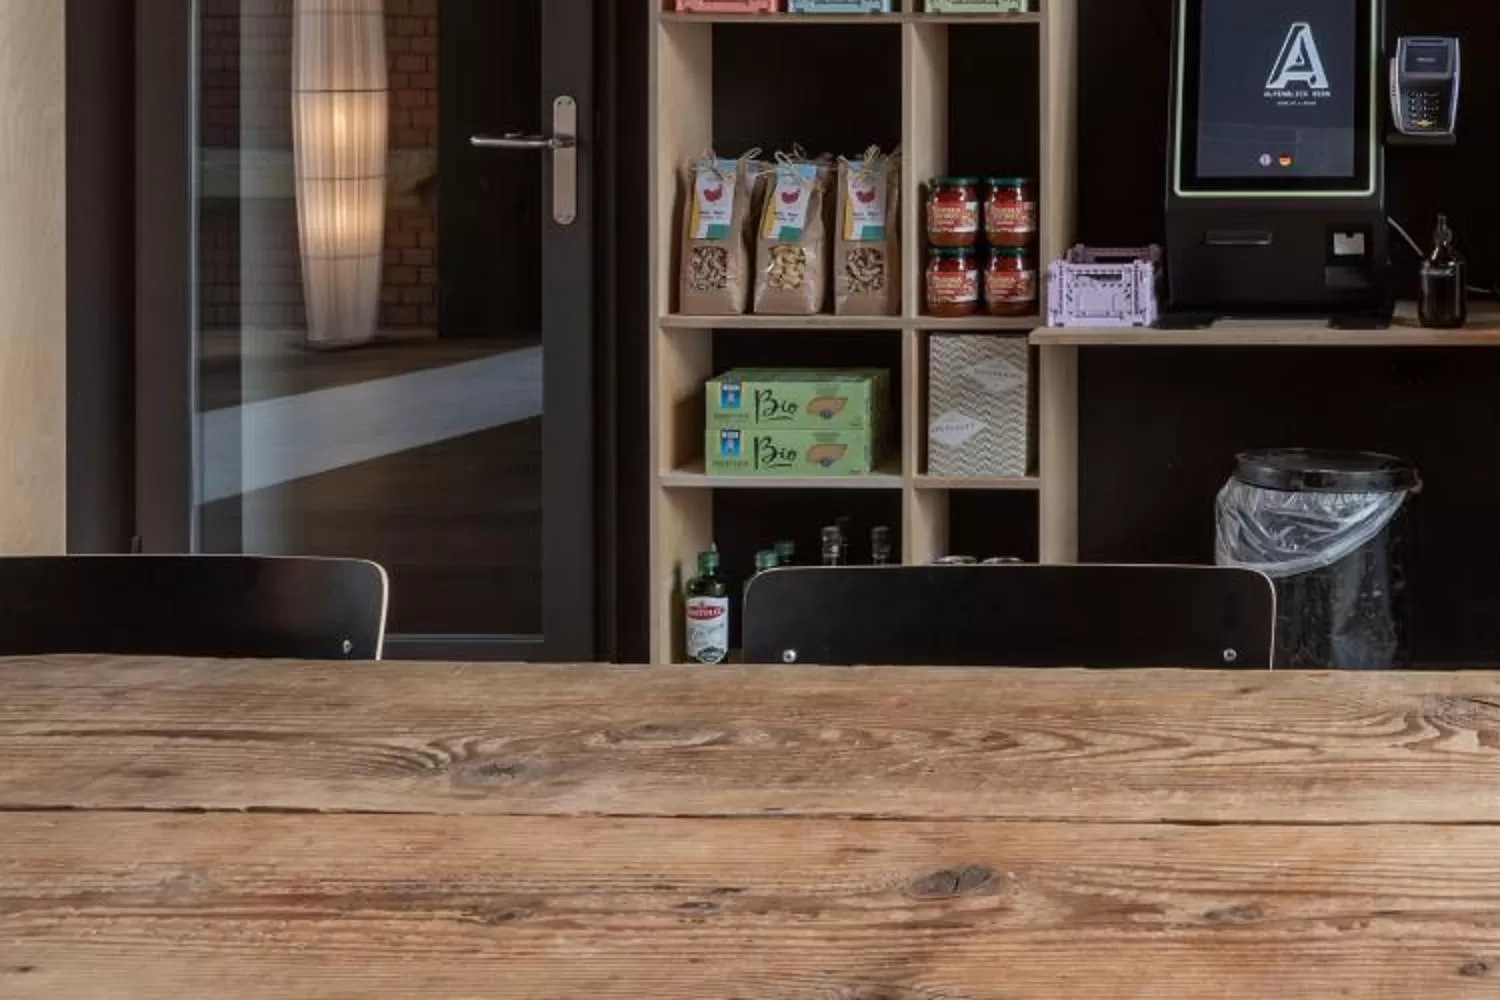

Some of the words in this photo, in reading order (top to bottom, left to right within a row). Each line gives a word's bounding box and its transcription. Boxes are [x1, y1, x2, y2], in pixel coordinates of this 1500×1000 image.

[1265, 22, 1329, 89] A
[754, 387, 799, 425] Bio
[753, 435, 798, 470] Bio
